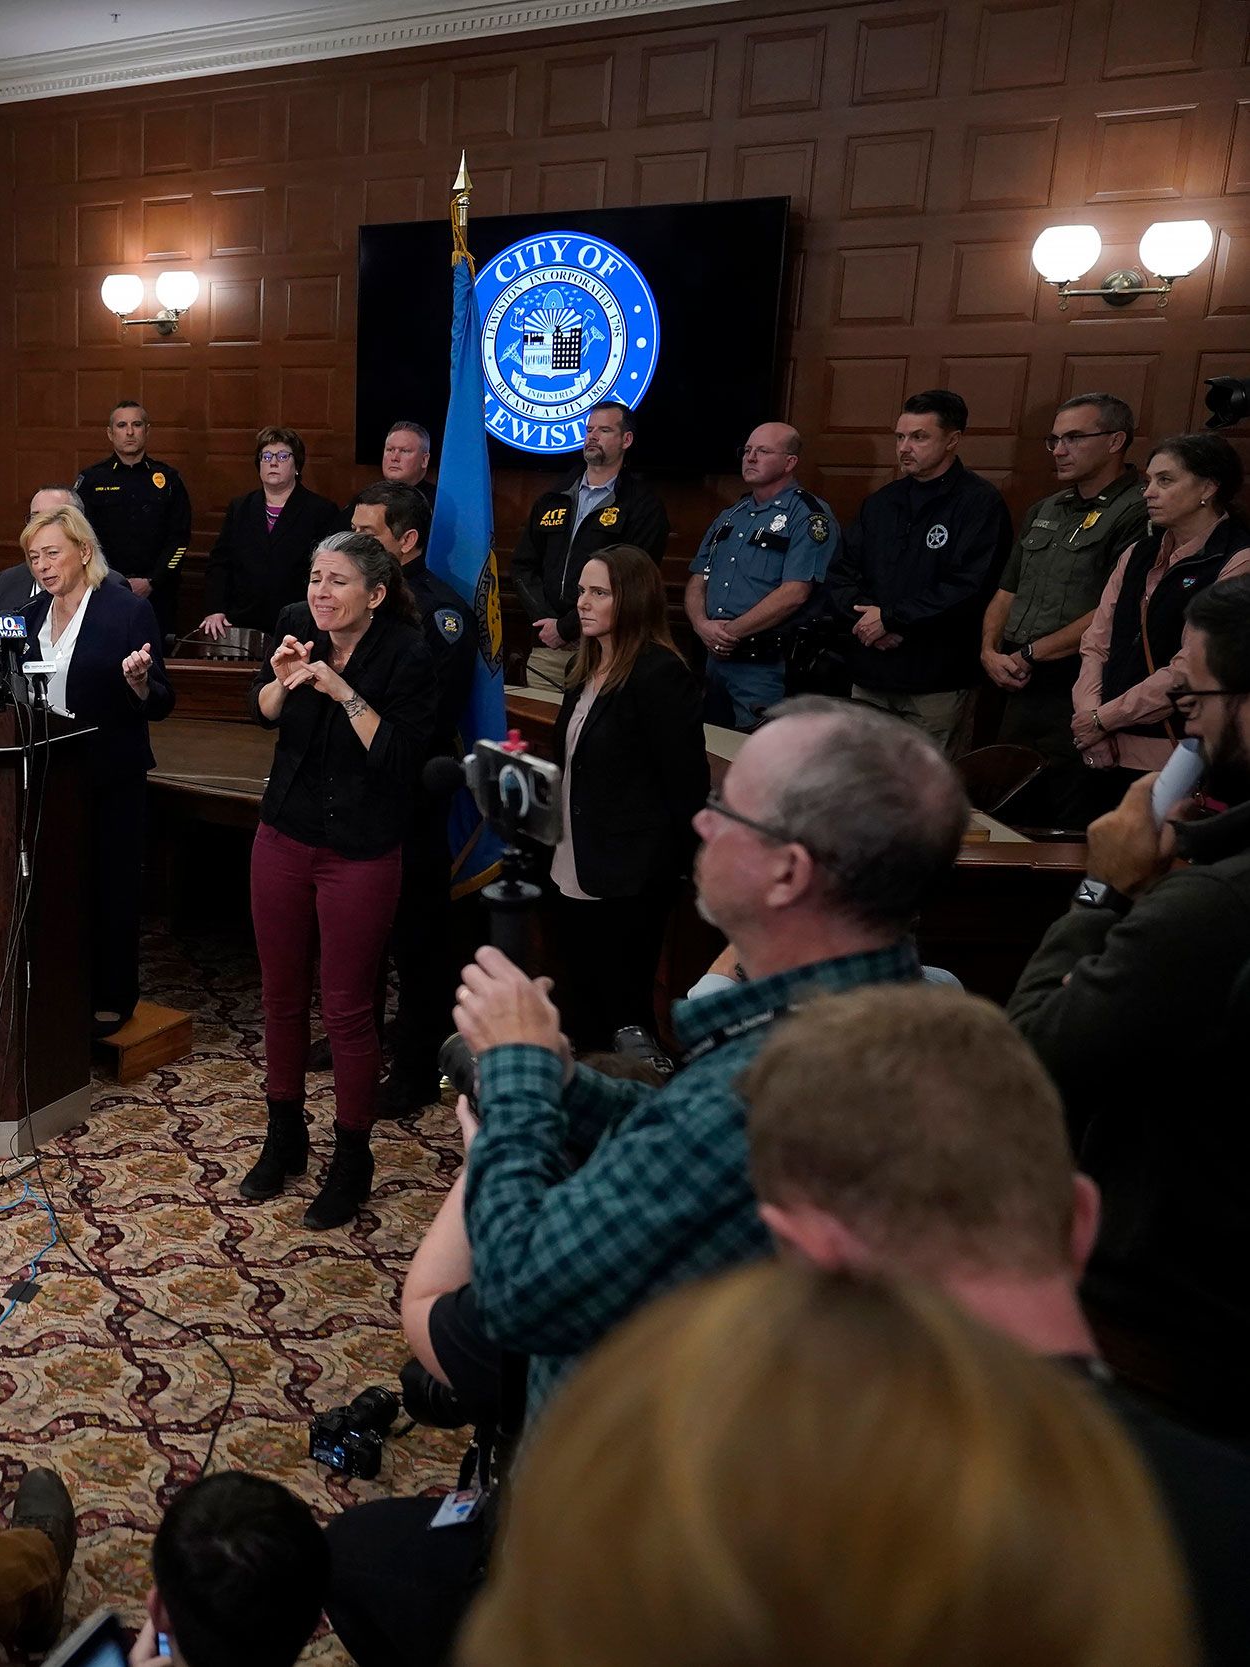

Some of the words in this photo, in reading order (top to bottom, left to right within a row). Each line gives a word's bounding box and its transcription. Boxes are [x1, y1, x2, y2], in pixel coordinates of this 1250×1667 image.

[495, 239, 572, 283] CITY
[578, 244, 623, 280] OF
[485, 282, 524, 340] LEWISTON
[529, 271, 614, 309] INCORPORATED
[609, 310, 623, 339] 1795
[495, 381, 537, 416] BECAME
[542, 408, 550, 416] A
[555, 401, 584, 416] CITY
[588, 379, 609, 401] 1863
[527, 388, 575, 401] INDUSTRIA
[483, 389, 630, 446] LEWIST
[540, 519, 564, 527] POLICE
[542, 508, 567, 519] ATF
